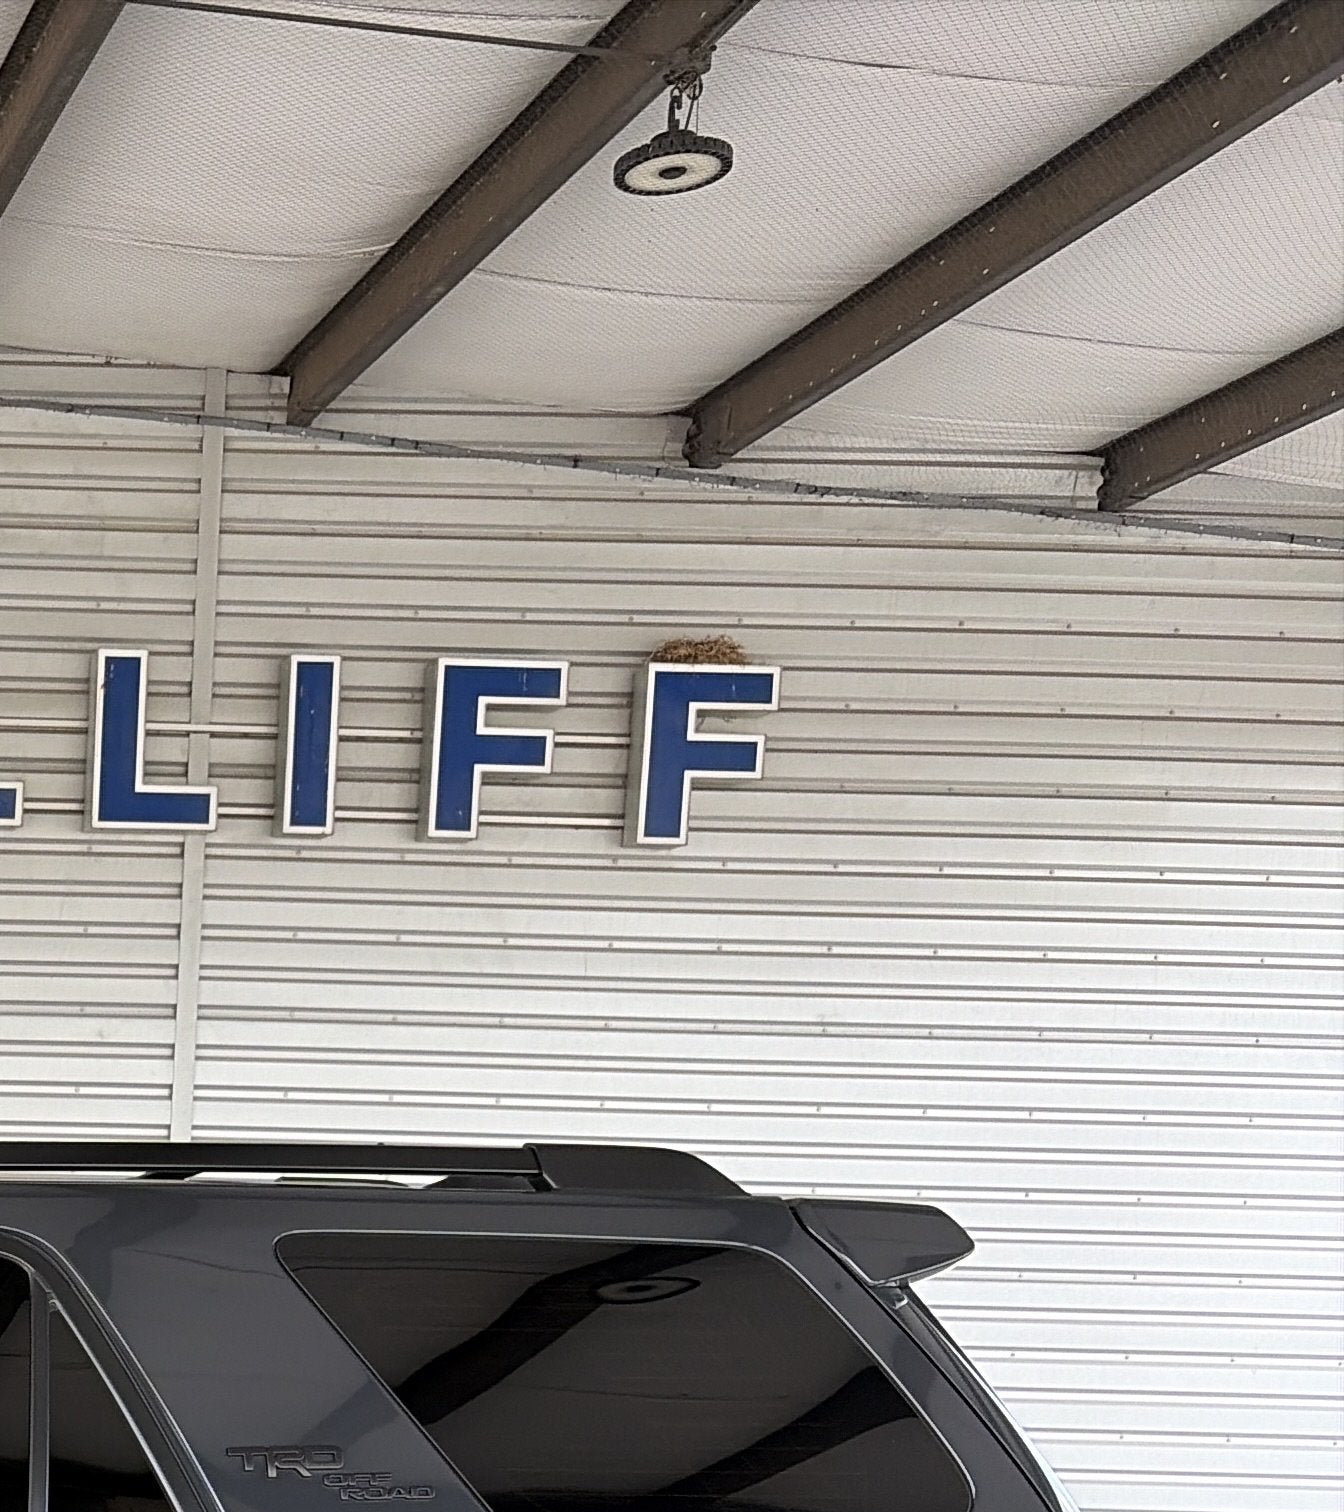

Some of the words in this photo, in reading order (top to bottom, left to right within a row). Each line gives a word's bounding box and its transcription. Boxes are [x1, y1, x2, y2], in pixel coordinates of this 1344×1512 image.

[226, 1445, 345, 1479] TRD
[322, 1473, 393, 1488] OFF
[339, 1487, 436, 1501] ROAD
